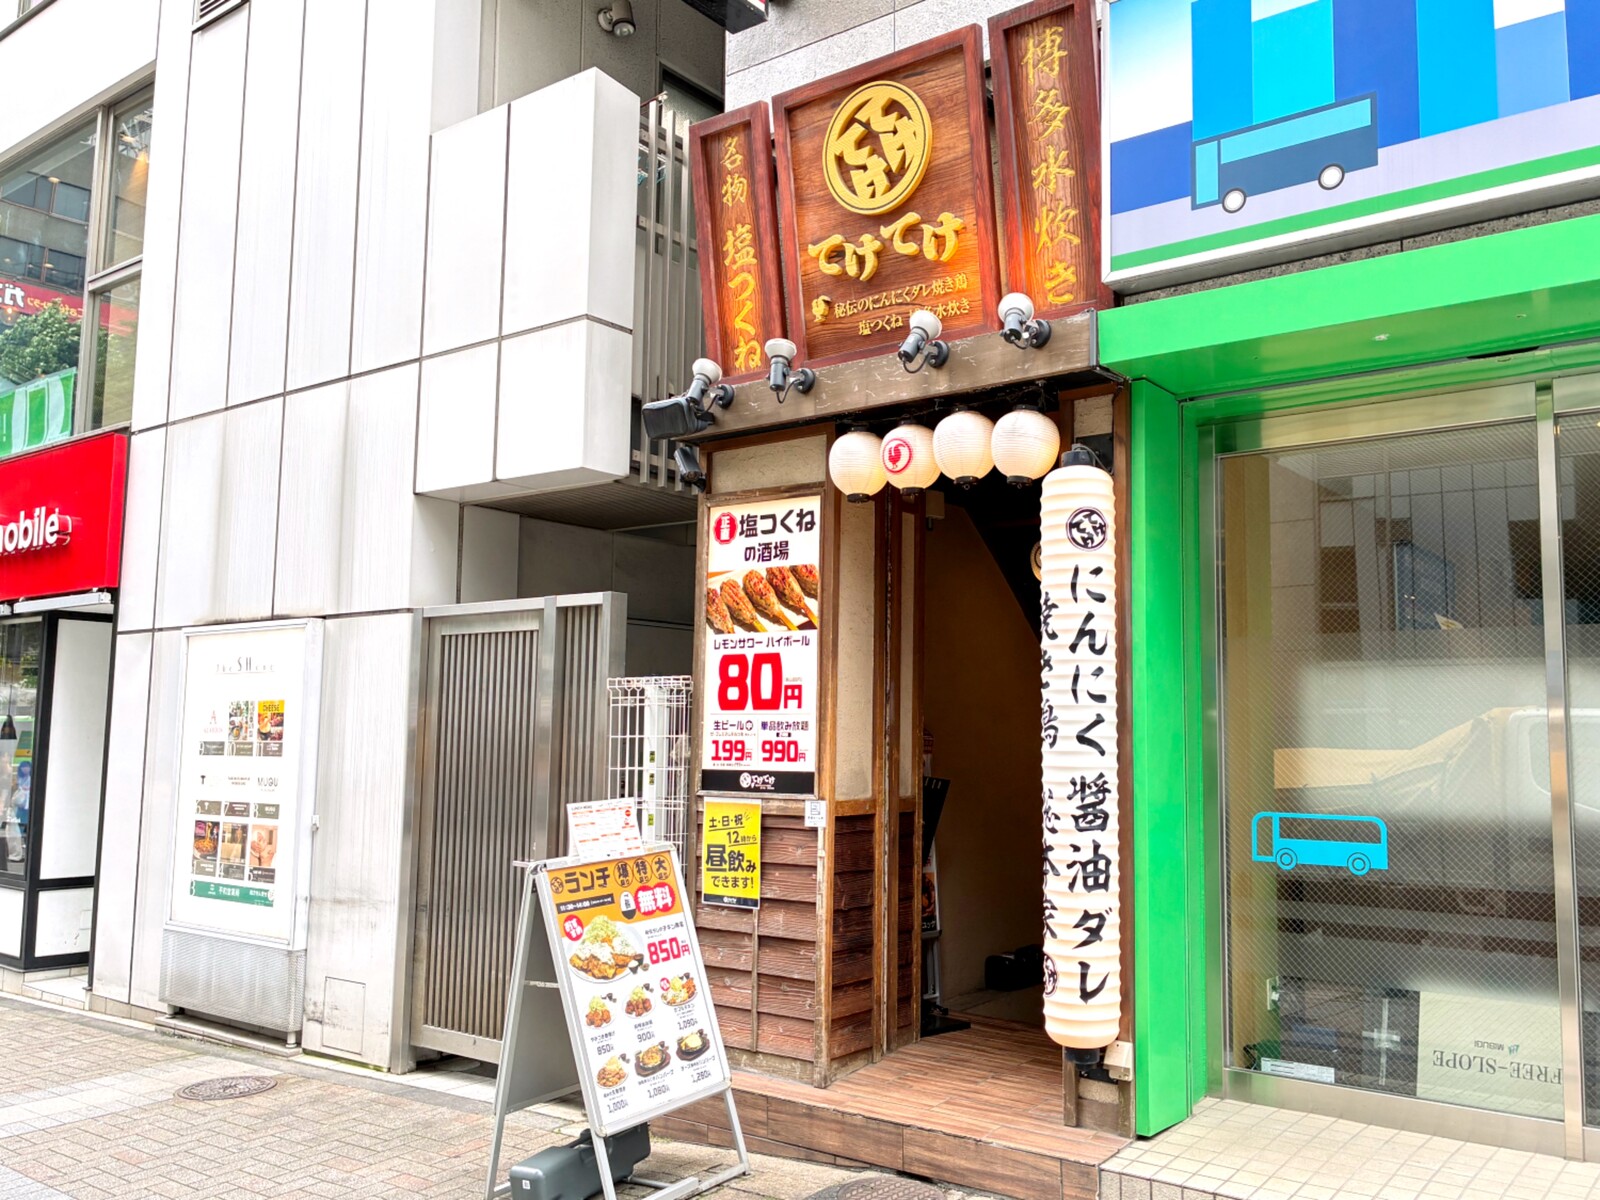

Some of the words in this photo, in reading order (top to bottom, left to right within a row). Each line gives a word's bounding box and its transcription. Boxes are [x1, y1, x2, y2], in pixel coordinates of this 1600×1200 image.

[720, 136, 748, 207] 名物
[1021, 25, 1081, 305] 博多水炊き
[807, 211, 966, 282] てけてけ
[722, 223, 763, 372] 塩つくね
[858, 313, 904, 336] 塩つくね
[739, 508, 816, 538] 塩つくね
[744, 540, 790, 563] の酒場
[714, 637, 763, 650] レモンサワー
[766, 635, 810, 648] ハイボール
[717, 652, 803, 711] 80円
[1066, 564, 1112, 1004] にんにく醤油ダレ
[706, 844, 756, 873] 昼飲み
[565, 867, 610, 893] ランチ
[637, 886, 673, 913] 無料
[1432, 1049, 1563, 1085] FREE-SLOPE
